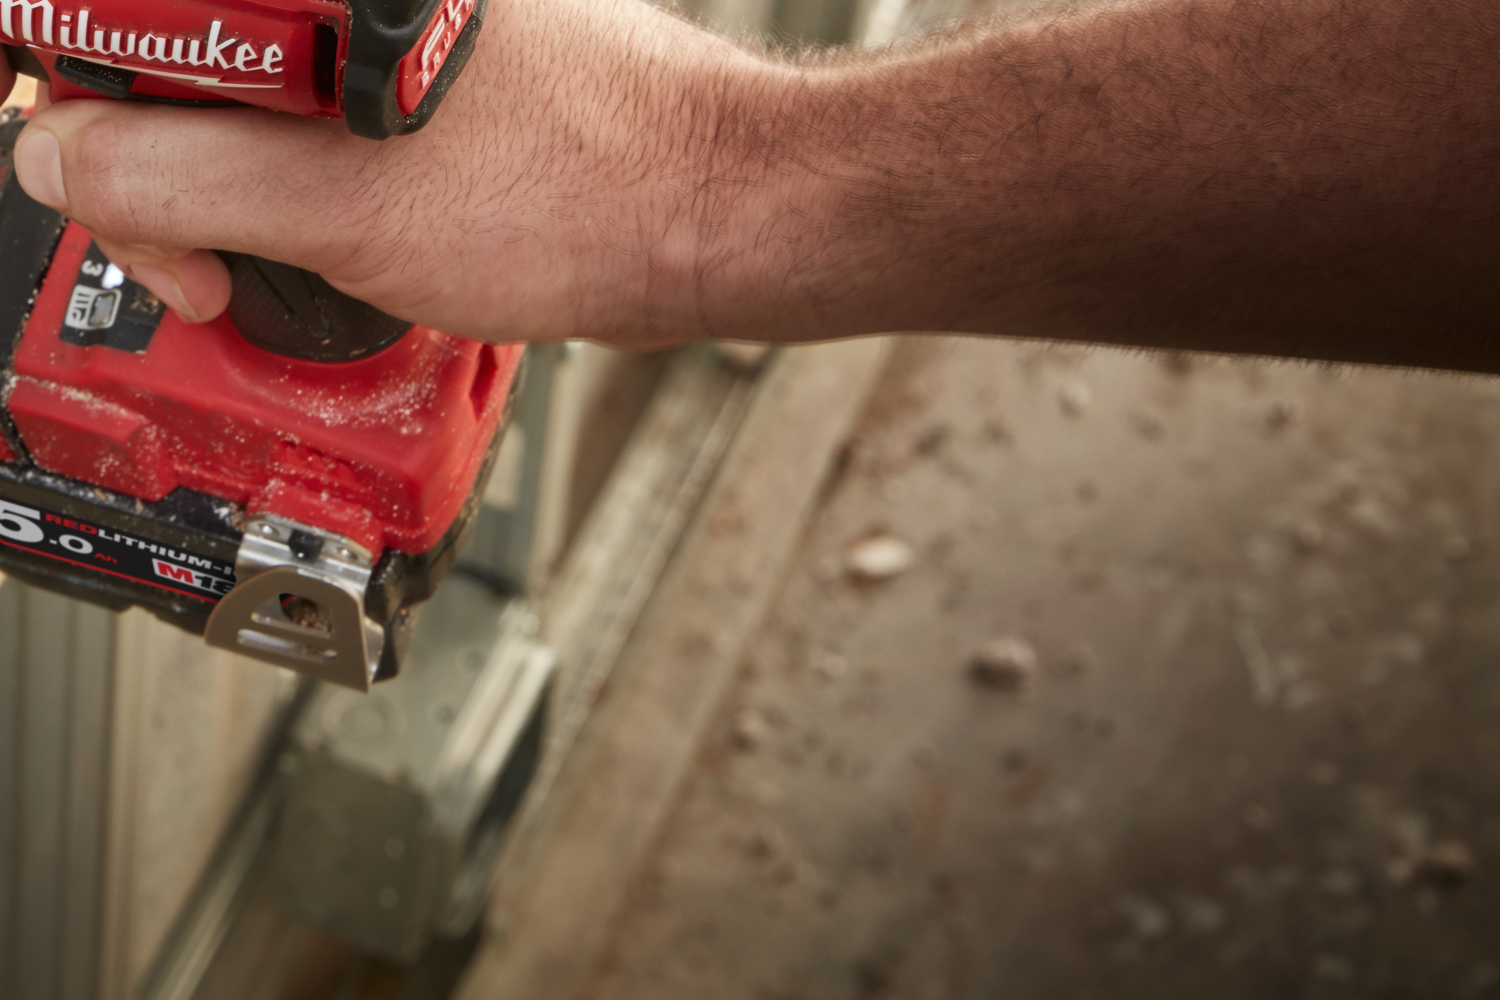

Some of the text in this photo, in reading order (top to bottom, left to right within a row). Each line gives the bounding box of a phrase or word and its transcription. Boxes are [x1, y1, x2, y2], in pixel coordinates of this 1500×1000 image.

[81, 260, 103, 276] 3
[45, 513, 236, 576] REDLITHIUM-I
[94, 552, 117, 564] Ah
